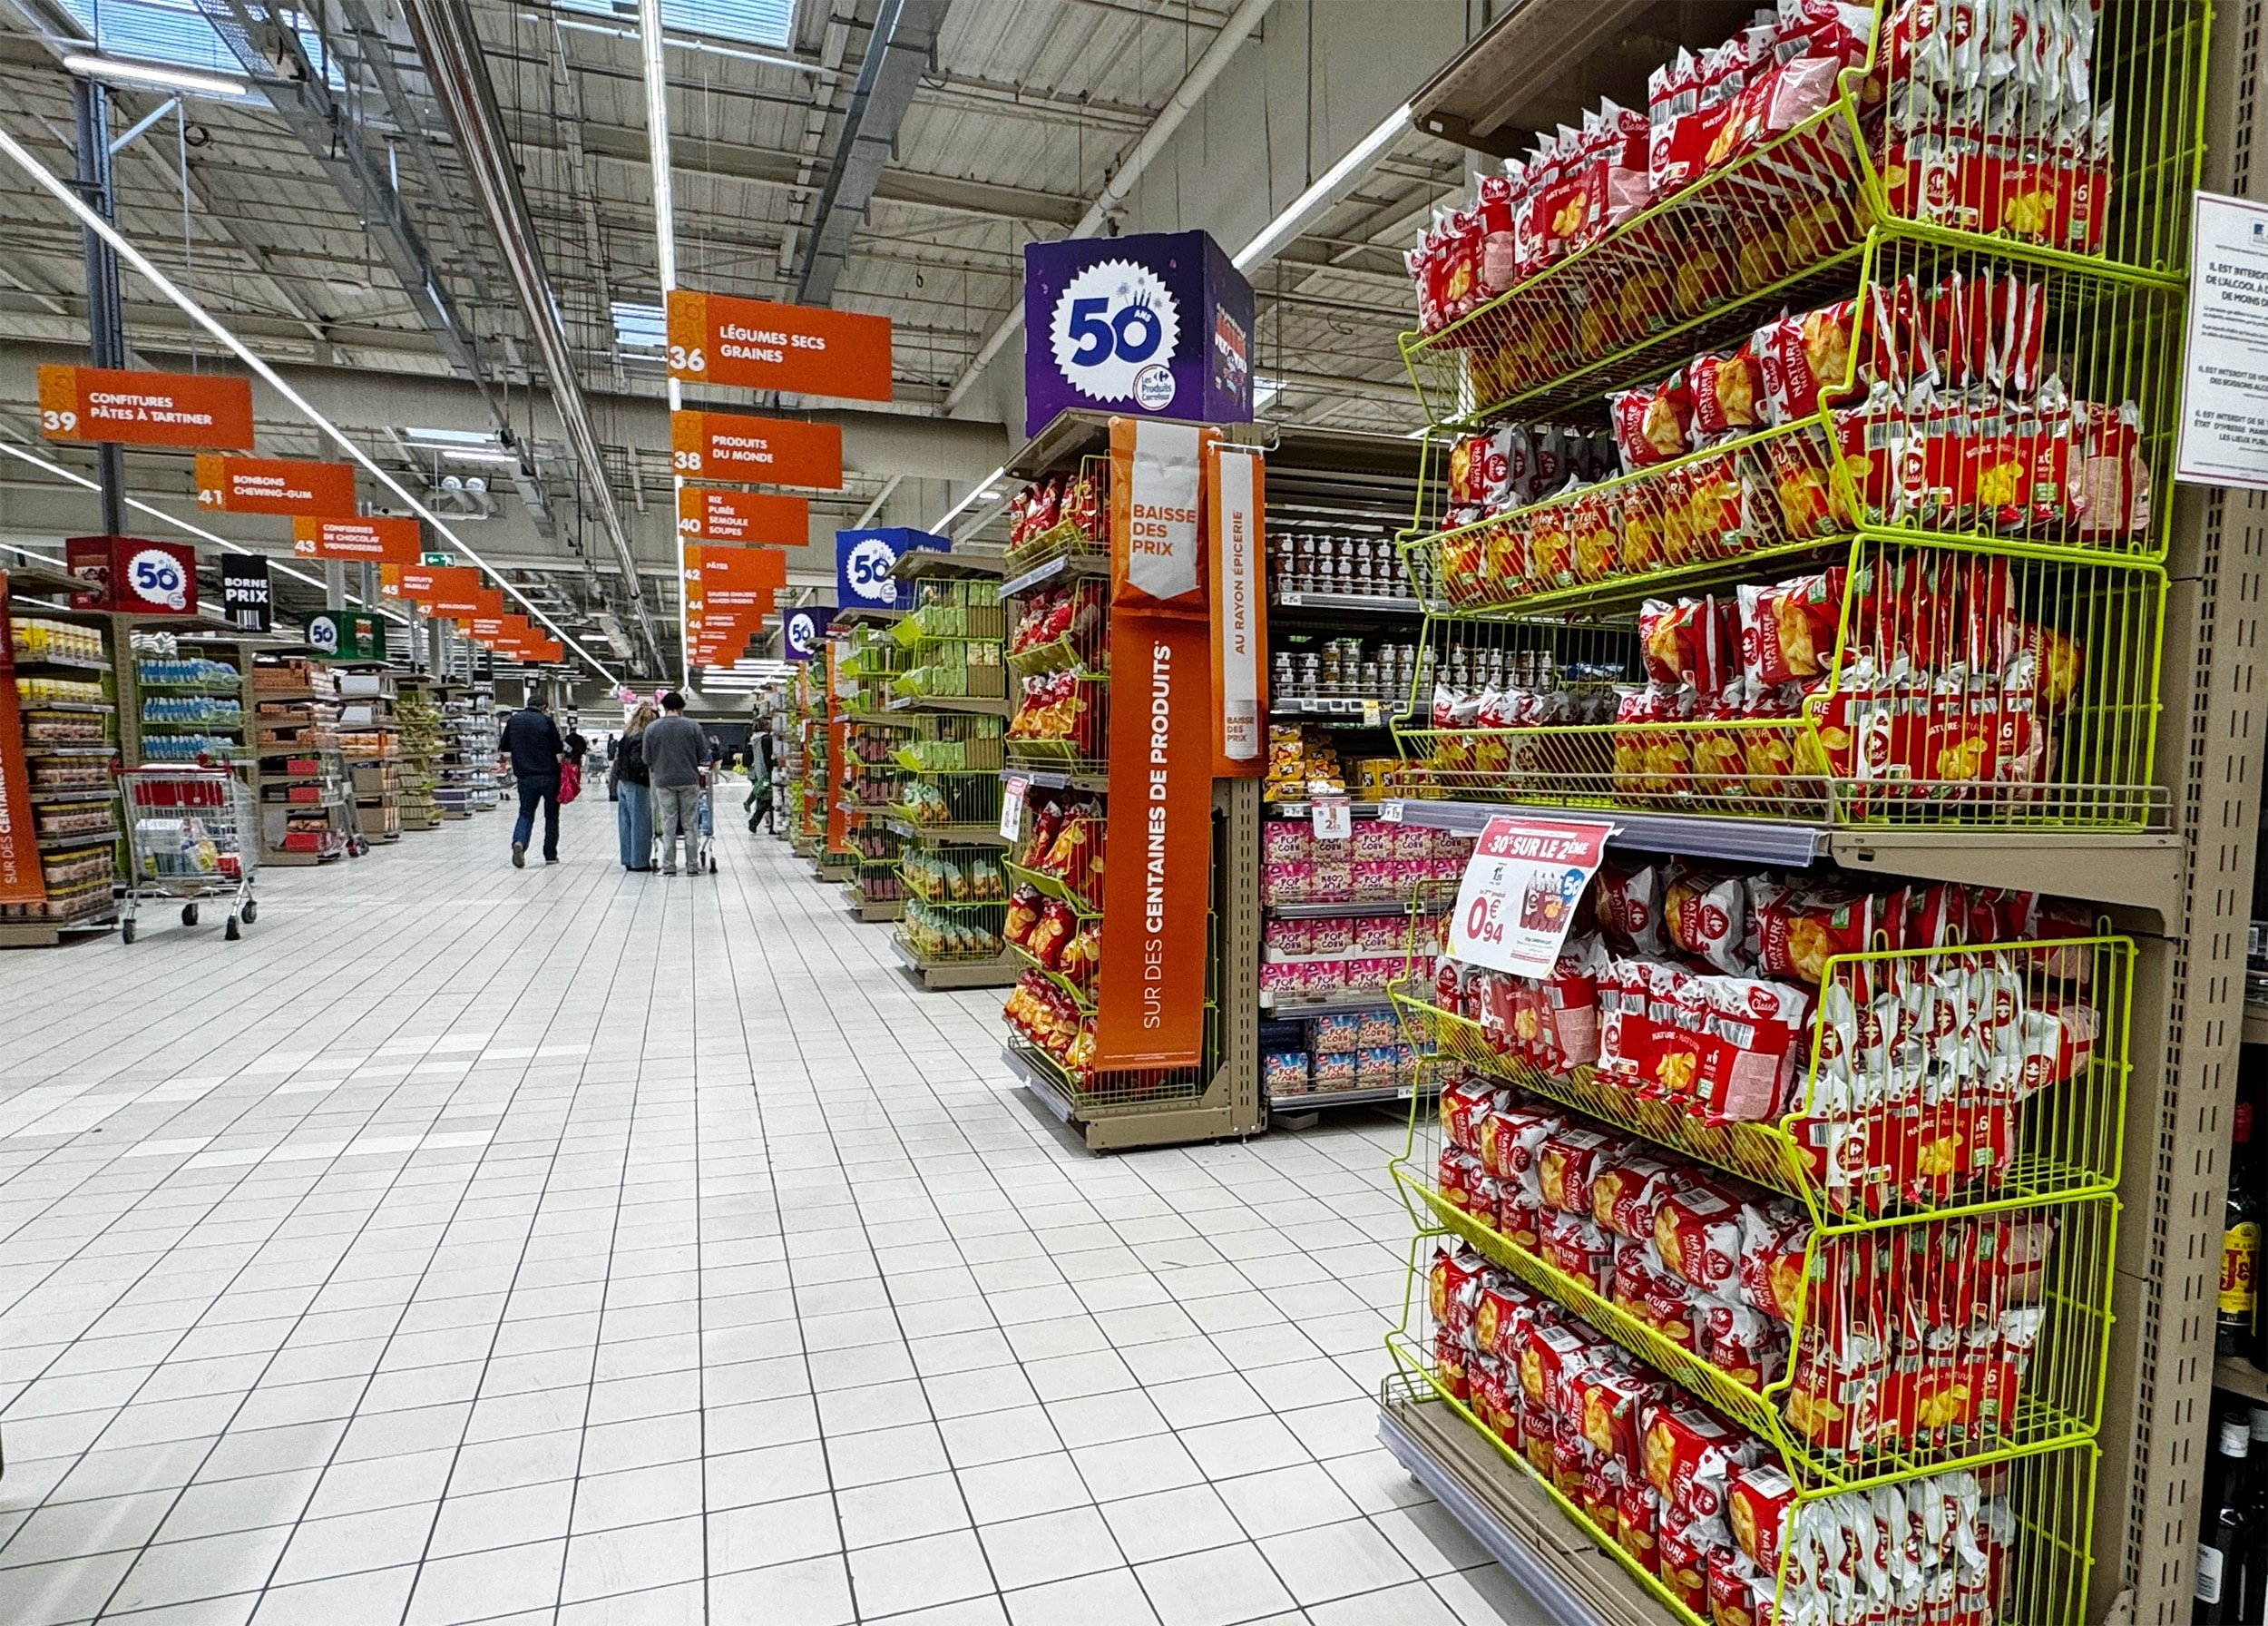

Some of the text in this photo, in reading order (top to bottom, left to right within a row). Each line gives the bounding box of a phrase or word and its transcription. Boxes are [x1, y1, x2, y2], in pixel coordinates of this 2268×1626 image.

[2218, 264, 2233, 274] EST
[2206, 275, 2218, 285] DE
[1134, 309, 1153, 322] ANS
[719, 324, 826, 350] LÉGUMES SECS
[1067, 297, 1162, 367] 50
[669, 346, 706, 372] 36
[720, 344, 784, 363] GRAINES
[1784, 337, 1802, 399] NATURE
[1141, 383, 1172, 394] Produits
[89, 392, 174, 408] CONFITURES
[1702, 369, 1713, 425] NATURE
[43, 410, 77, 431] 39
[91, 405, 212, 426] PÂTES À TARTINER
[1627, 405, 1638, 455] NATURE
[712, 435, 767, 449] PRODUITS
[674, 450, 701, 470] 38
[712, 449, 774, 463] DU MONDE
[1472, 446, 1481, 490] NATURE
[232, 474, 285, 487] BONBONS
[198, 489, 223, 505] 41
[1133, 504, 1196, 524] BAISSE
[679, 517, 701, 533] 40
[1132, 522, 1168, 538] DES
[294, 539, 317, 553] 43
[1132, 539, 1175, 556] PRIX
[685, 569, 701, 581] 42
[854, 554, 891, 584] 50
[136, 562, 180, 591] 50
[1232, 510, 1246, 655] AU RAYON ÉPICERIE
[224, 578, 269, 590] BORNE
[382, 584, 399, 595] 45
[225, 588, 269, 604] PRIX
[417, 604, 433, 614] 47
[688, 600, 704, 610] 44
[312, 625, 333, 643] 50
[792, 623, 811, 643] 50
[1763, 613, 1775, 671] NATURE
[1227, 715, 1255, 725] BAISSE
[1227, 725, 1245, 734] DES
[1227, 733, 1247, 743] PRIX
[1149, 769, 1168, 801] DE
[1280, 835, 1300, 844] POP
[1364, 834, 1383, 843] POP
[1403, 832, 1423, 842] POP
[3, 835, 13, 857] DES
[1277, 843, 1301, 852] CORN
[1318, 844, 1342, 852] CORN
[1361, 842, 1384, 851] CORN
[1510, 836, 1540, 857] SUR
[1540, 839, 1558, 858] LE
[5, 859, 17, 885] SUR
[1145, 806, 1167, 934] CENTAINES
[1280, 877, 1301, 886] POP
[1364, 875, 1384, 884] POP
[1403, 873, 1423, 883] POP
[1467, 896, 1488, 940] 0
[1482, 921, 1504, 945] 94
[1281, 933, 1300, 942] POP
[1324, 932, 1344, 941] POP
[1364, 938, 1388, 947] CORN
[1366, 931, 1387, 940] POP
[1767, 915, 1784, 970] NATURE
[1278, 941, 1302, 950] CORN
[1321, 940, 1344, 948] CORN
[1143, 937, 1163, 981] DES
[1275, 977, 1295, 986] POP
[1316, 975, 1336, 984] POP
[1359, 973, 1380, 982] POP
[1143, 984, 1161, 1030] SUR
[1751, 997, 1777, 1013] Classic
[1329, 1027, 1349, 1036] POP
[1367, 1021, 1387, 1030] POP
[1364, 1029, 1387, 1037] CORN
[1651, 1031, 1677, 1042] NATURE
[1706, 1049, 1719, 1065] x6
[1278, 1066, 1298, 1075] POP
[1327, 1063, 1347, 1073] POP
[1367, 1060, 1387, 1069] POP
[1687, 1233, 1702, 1283] NATURE
